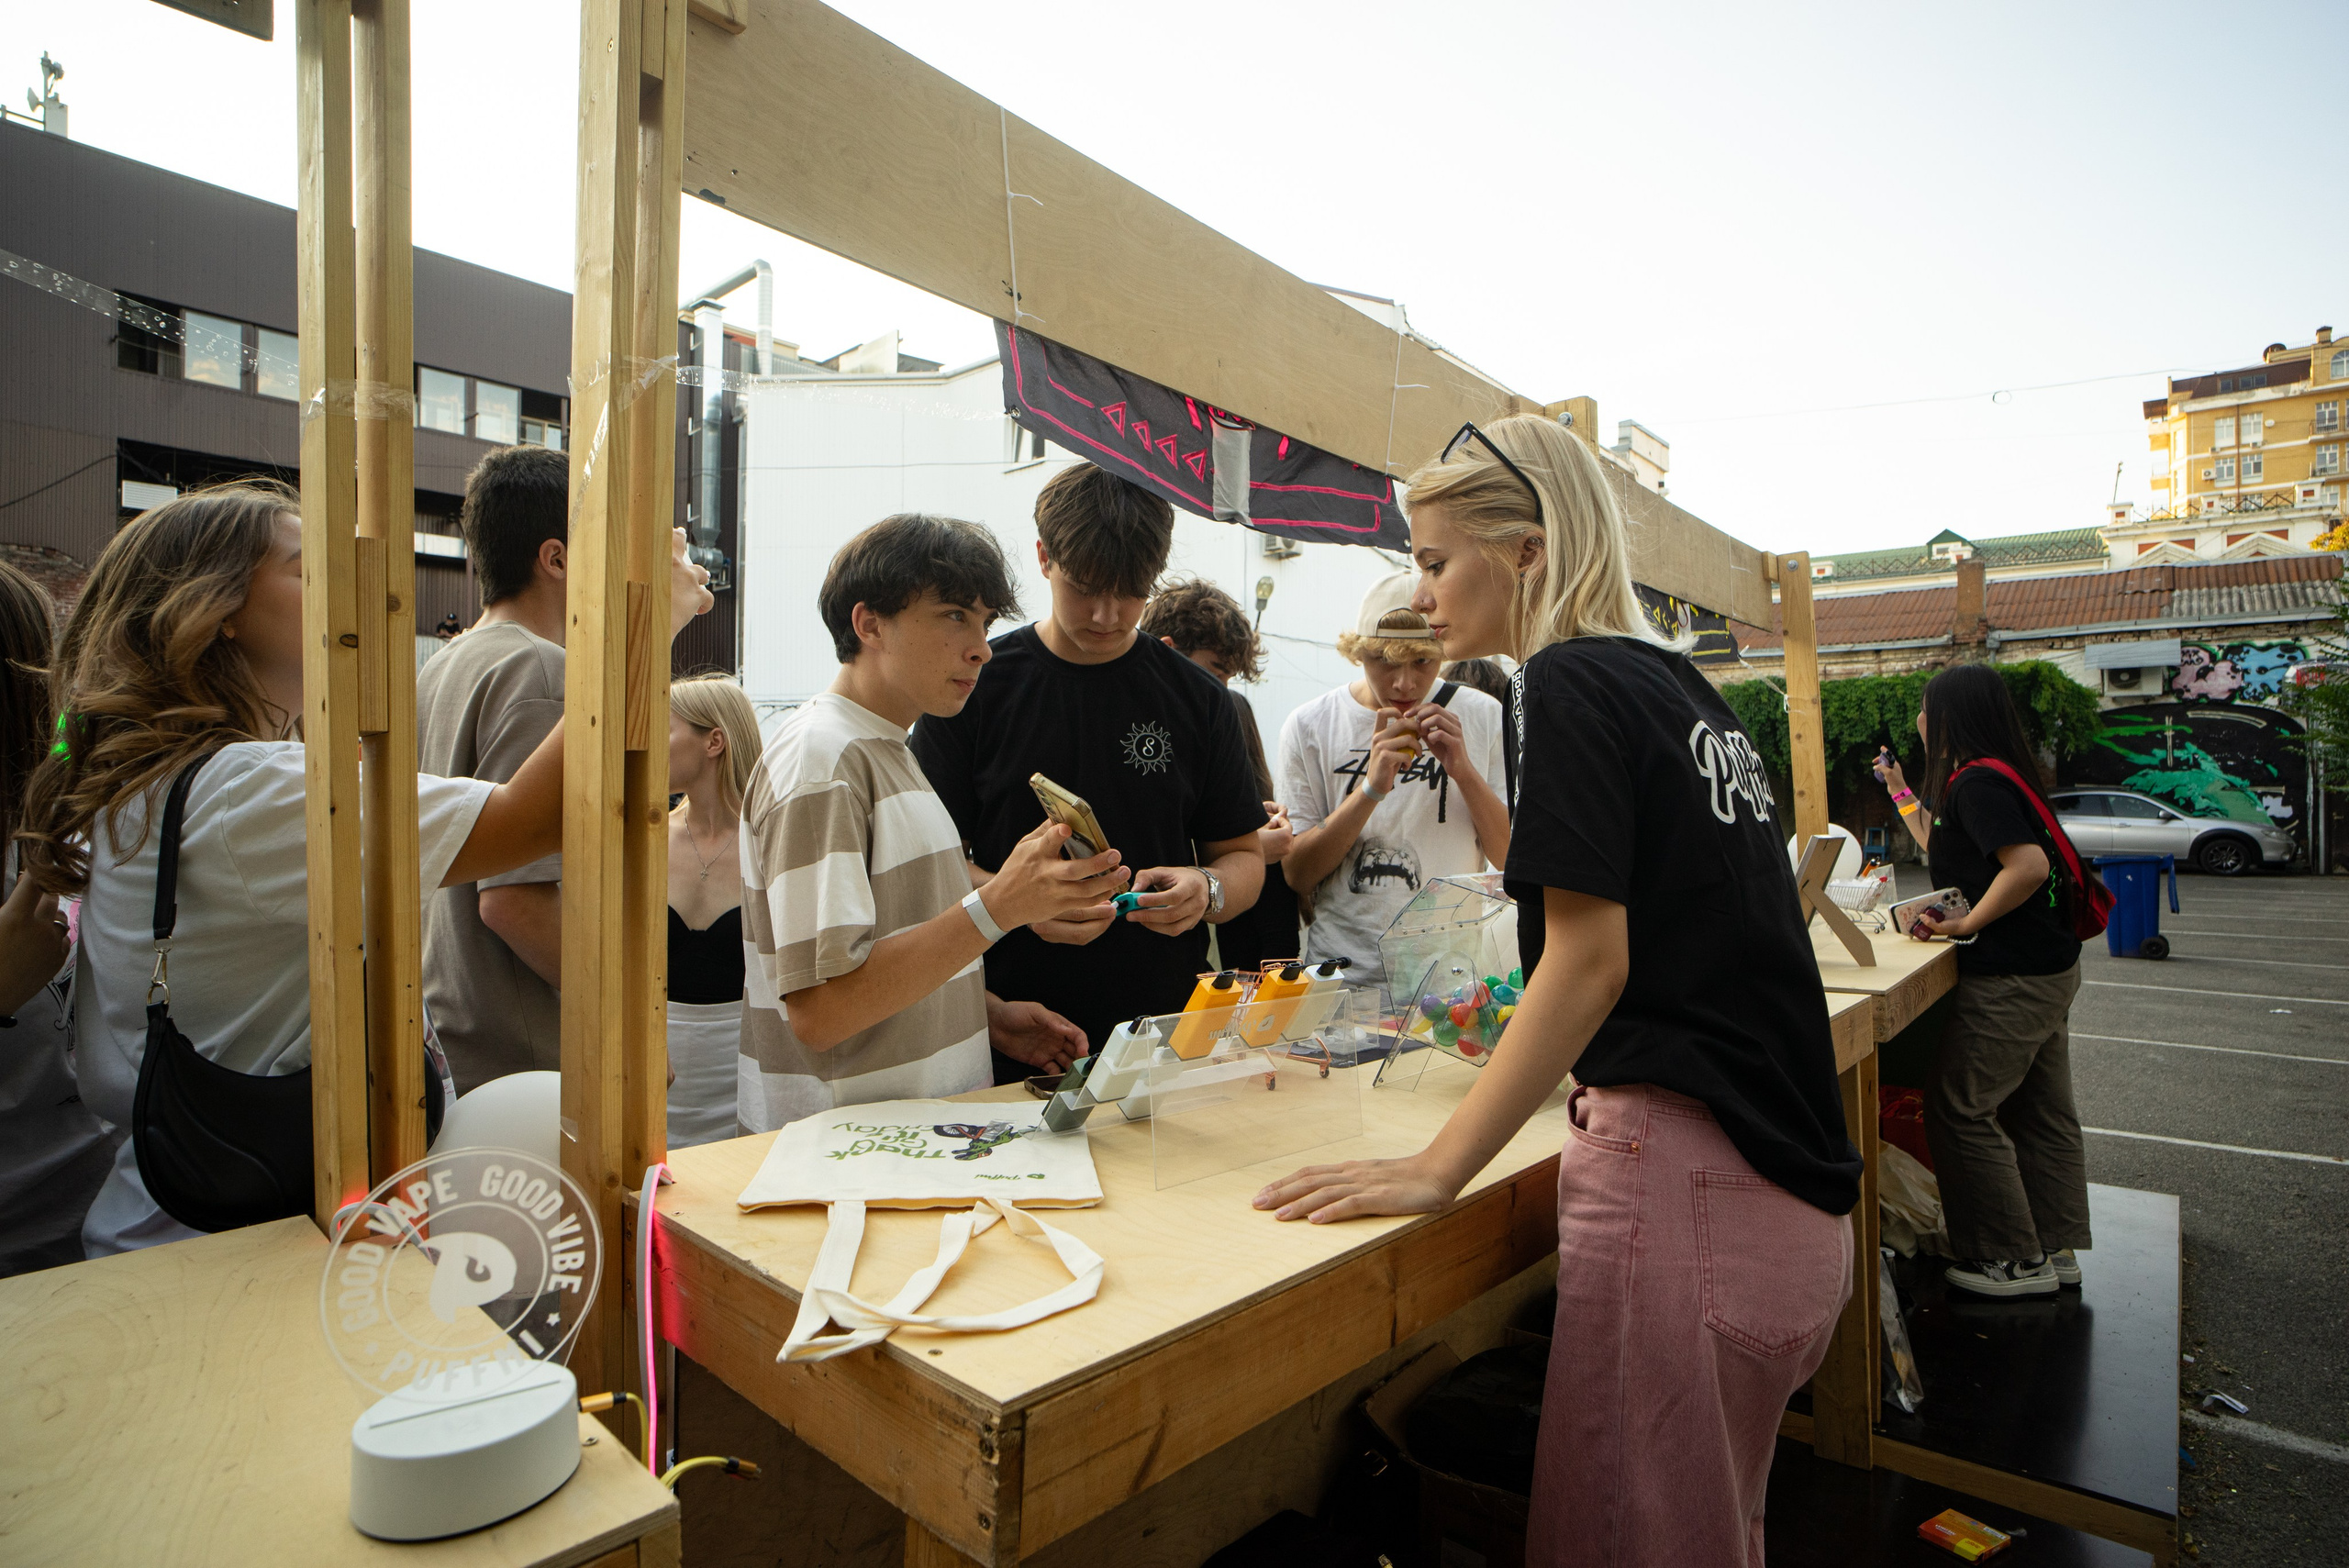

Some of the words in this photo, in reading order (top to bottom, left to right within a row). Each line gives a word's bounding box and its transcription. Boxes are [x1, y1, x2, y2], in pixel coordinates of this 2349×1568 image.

[337, 1241, 385, 1332] GOOD
[364, 1169, 459, 1238] VAPE
[480, 1164, 564, 1220] GOOD
[547, 1213, 586, 1295] VIBE
[379, 1329, 545, 1393] PUFFMI
